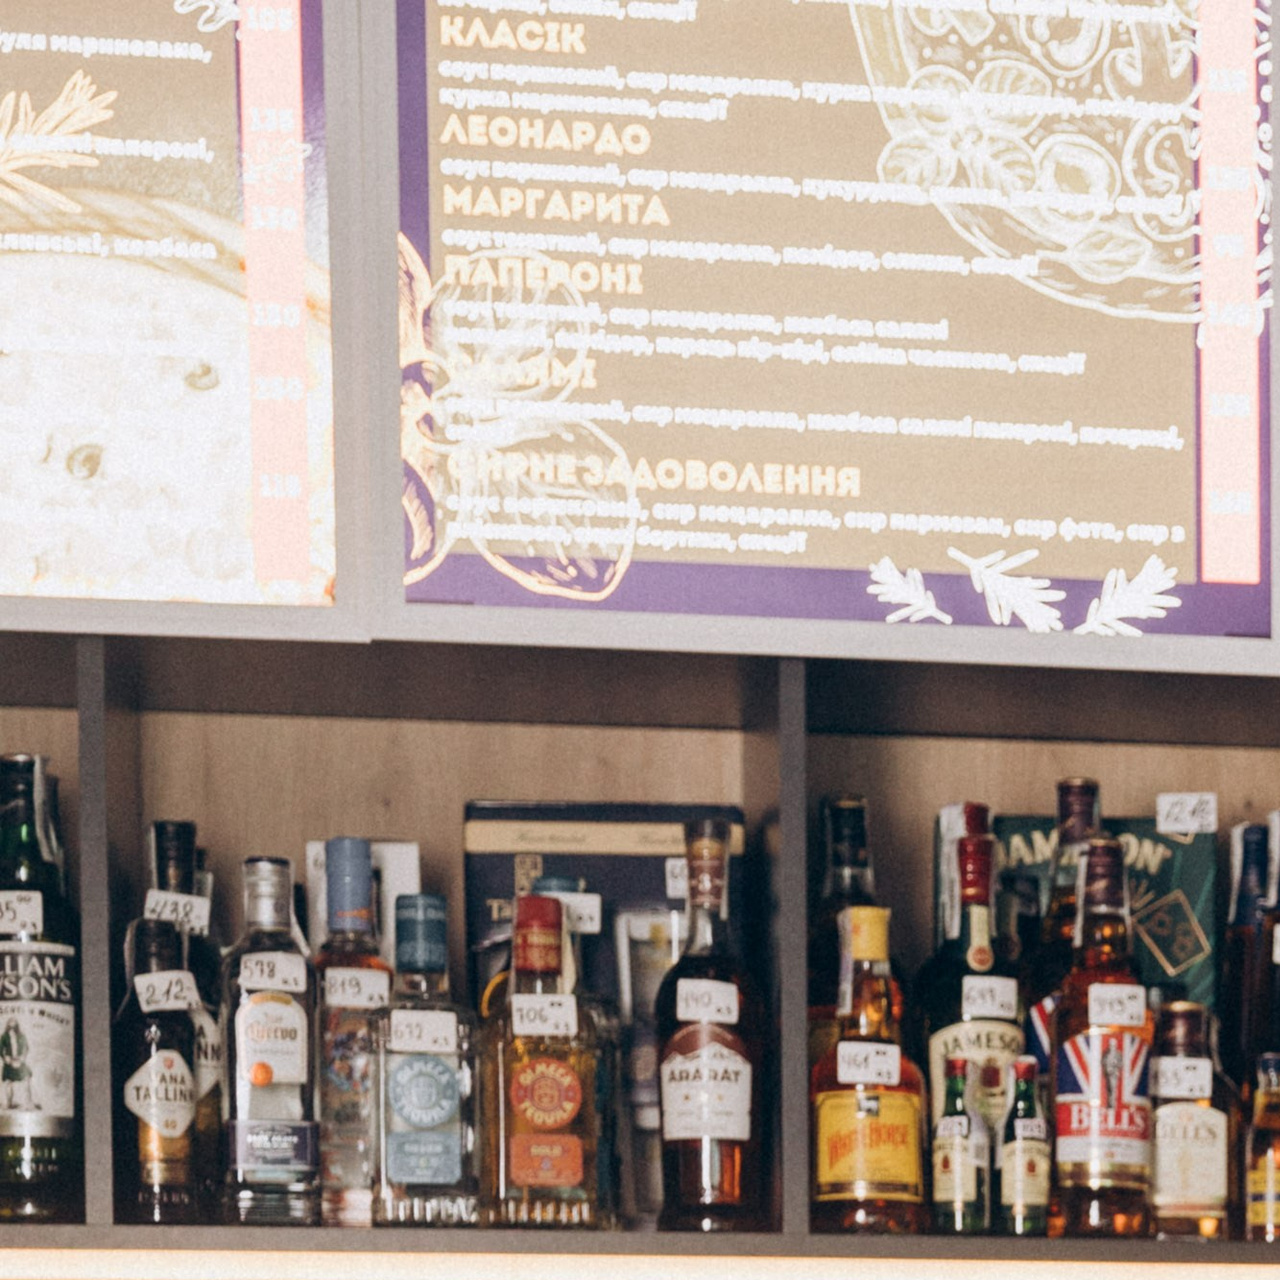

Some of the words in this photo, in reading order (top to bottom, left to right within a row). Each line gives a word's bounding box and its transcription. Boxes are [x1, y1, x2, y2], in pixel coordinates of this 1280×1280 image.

[438, 13, 587, 54] КЛАСІК
[439, 112, 650, 156] ЛЕОНАРДО
[441, 183, 670, 226] МАРГАРИТА
[443, 253, 643, 294] ПАПЕРОНІ
[583, 455, 861, 497] ЗАДОВОЛЕННЯ
[0, 954, 65, 978] LIAM
[0, 974, 72, 1000] SON'S
[519, 1062, 574, 1087] OLMECA
[667, 1067, 744, 1085] ARARAT
[1070, 1101, 1147, 1133] BELL'S
